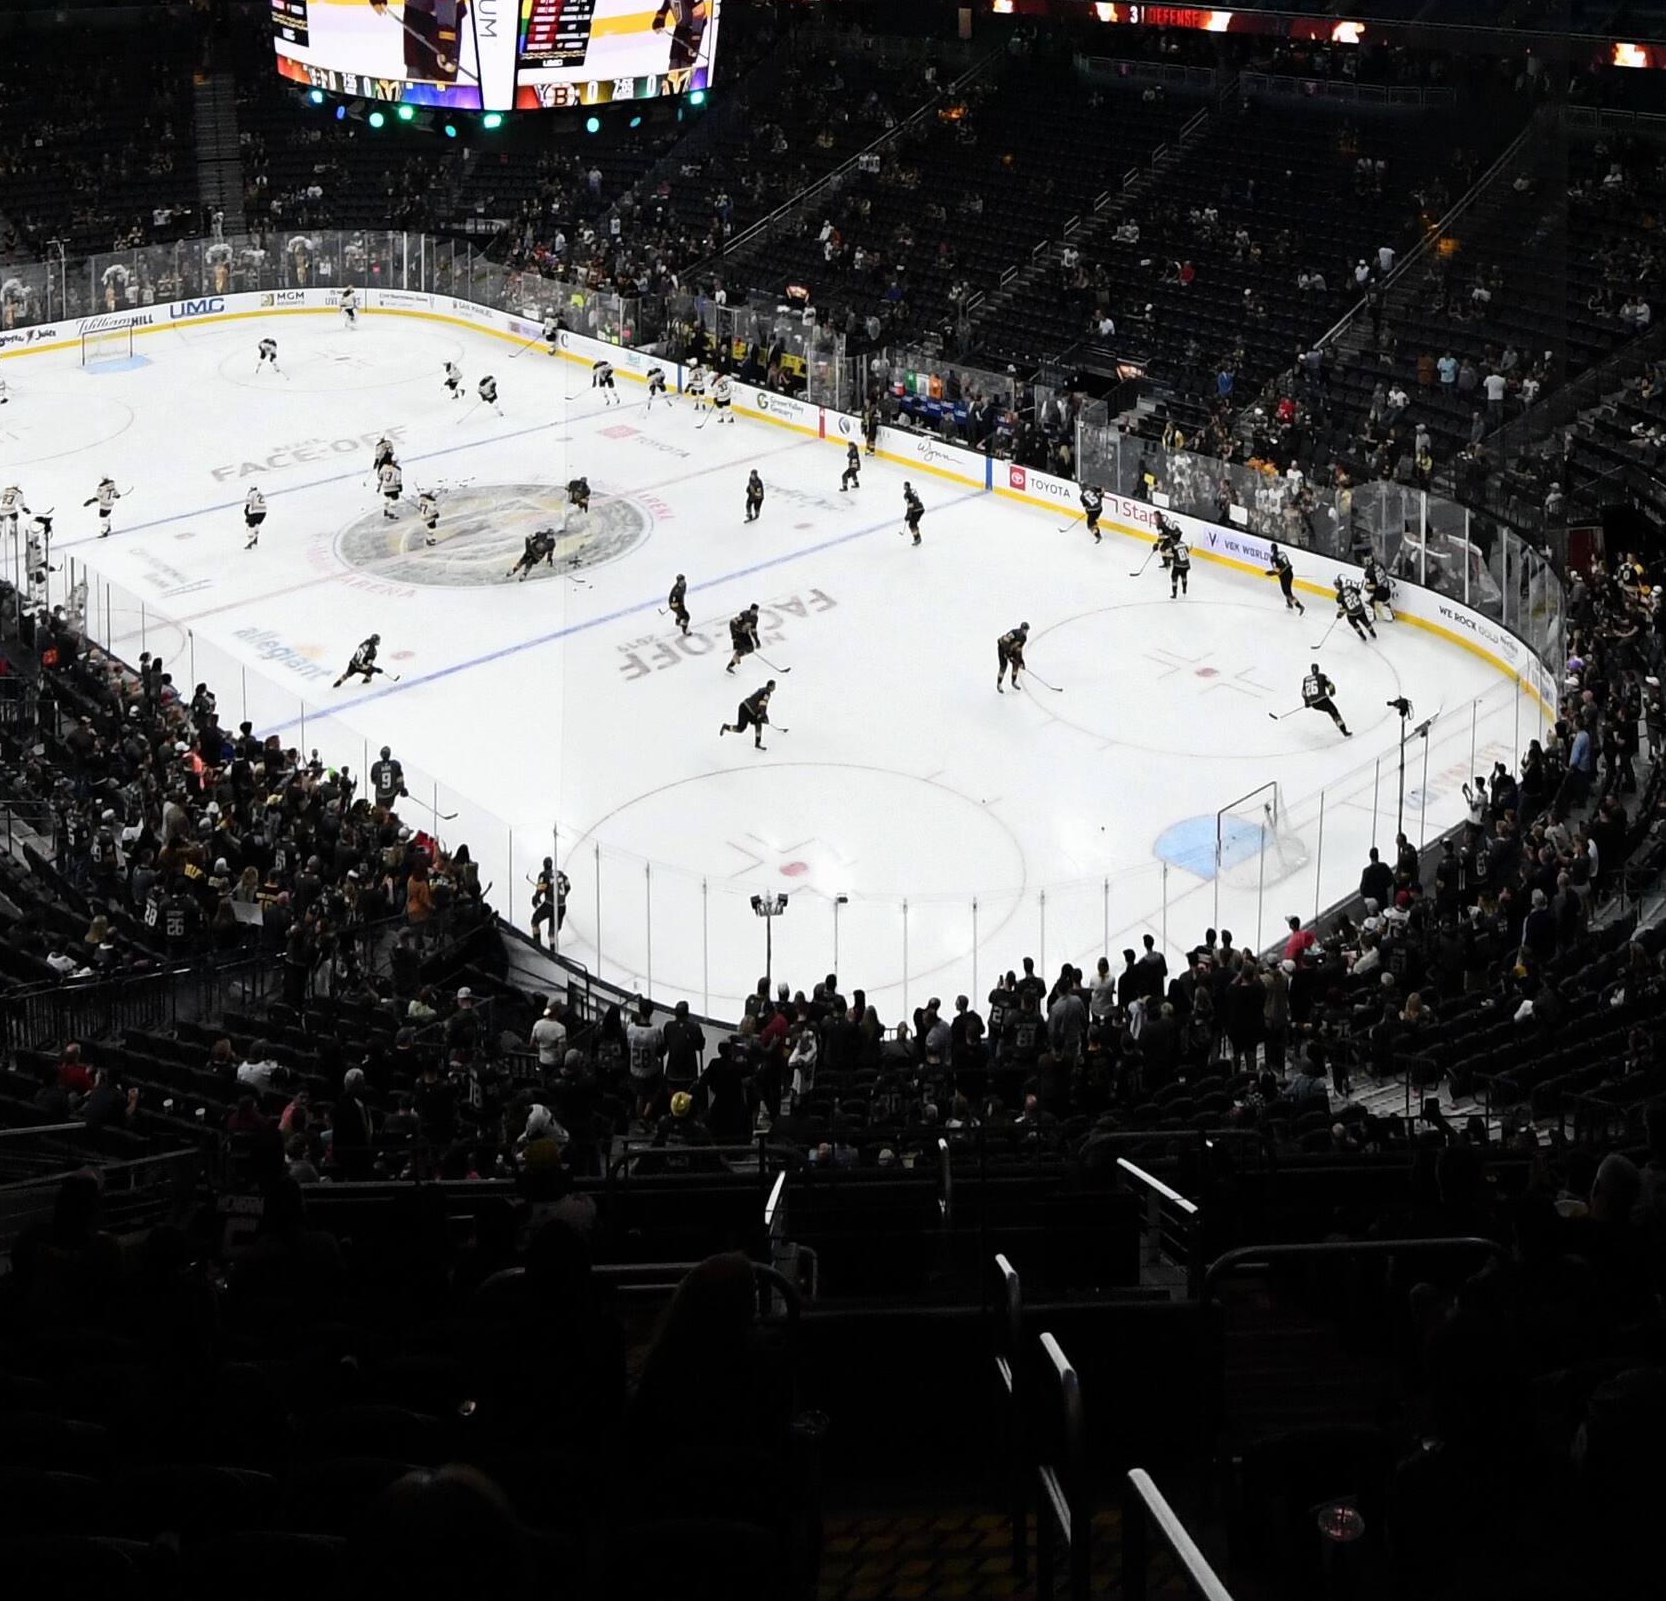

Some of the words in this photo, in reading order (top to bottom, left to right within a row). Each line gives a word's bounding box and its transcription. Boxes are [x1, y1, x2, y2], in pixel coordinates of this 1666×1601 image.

[1129, 5, 1139, 24] 3
[1148, 7, 1199, 28] DEFENSE
[587, 80, 598, 101] 0
[646, 74, 657, 96] 0
[276, 291, 305, 300] MGM
[169, 297, 226, 320] UMC
[132, 313, 154, 327] HILL
[1029, 477, 1071, 499] TOYOTA
[1438, 605, 1453, 619] WE
[1453, 611, 1478, 632] ROCK
[381, 772, 392, 789] 9
